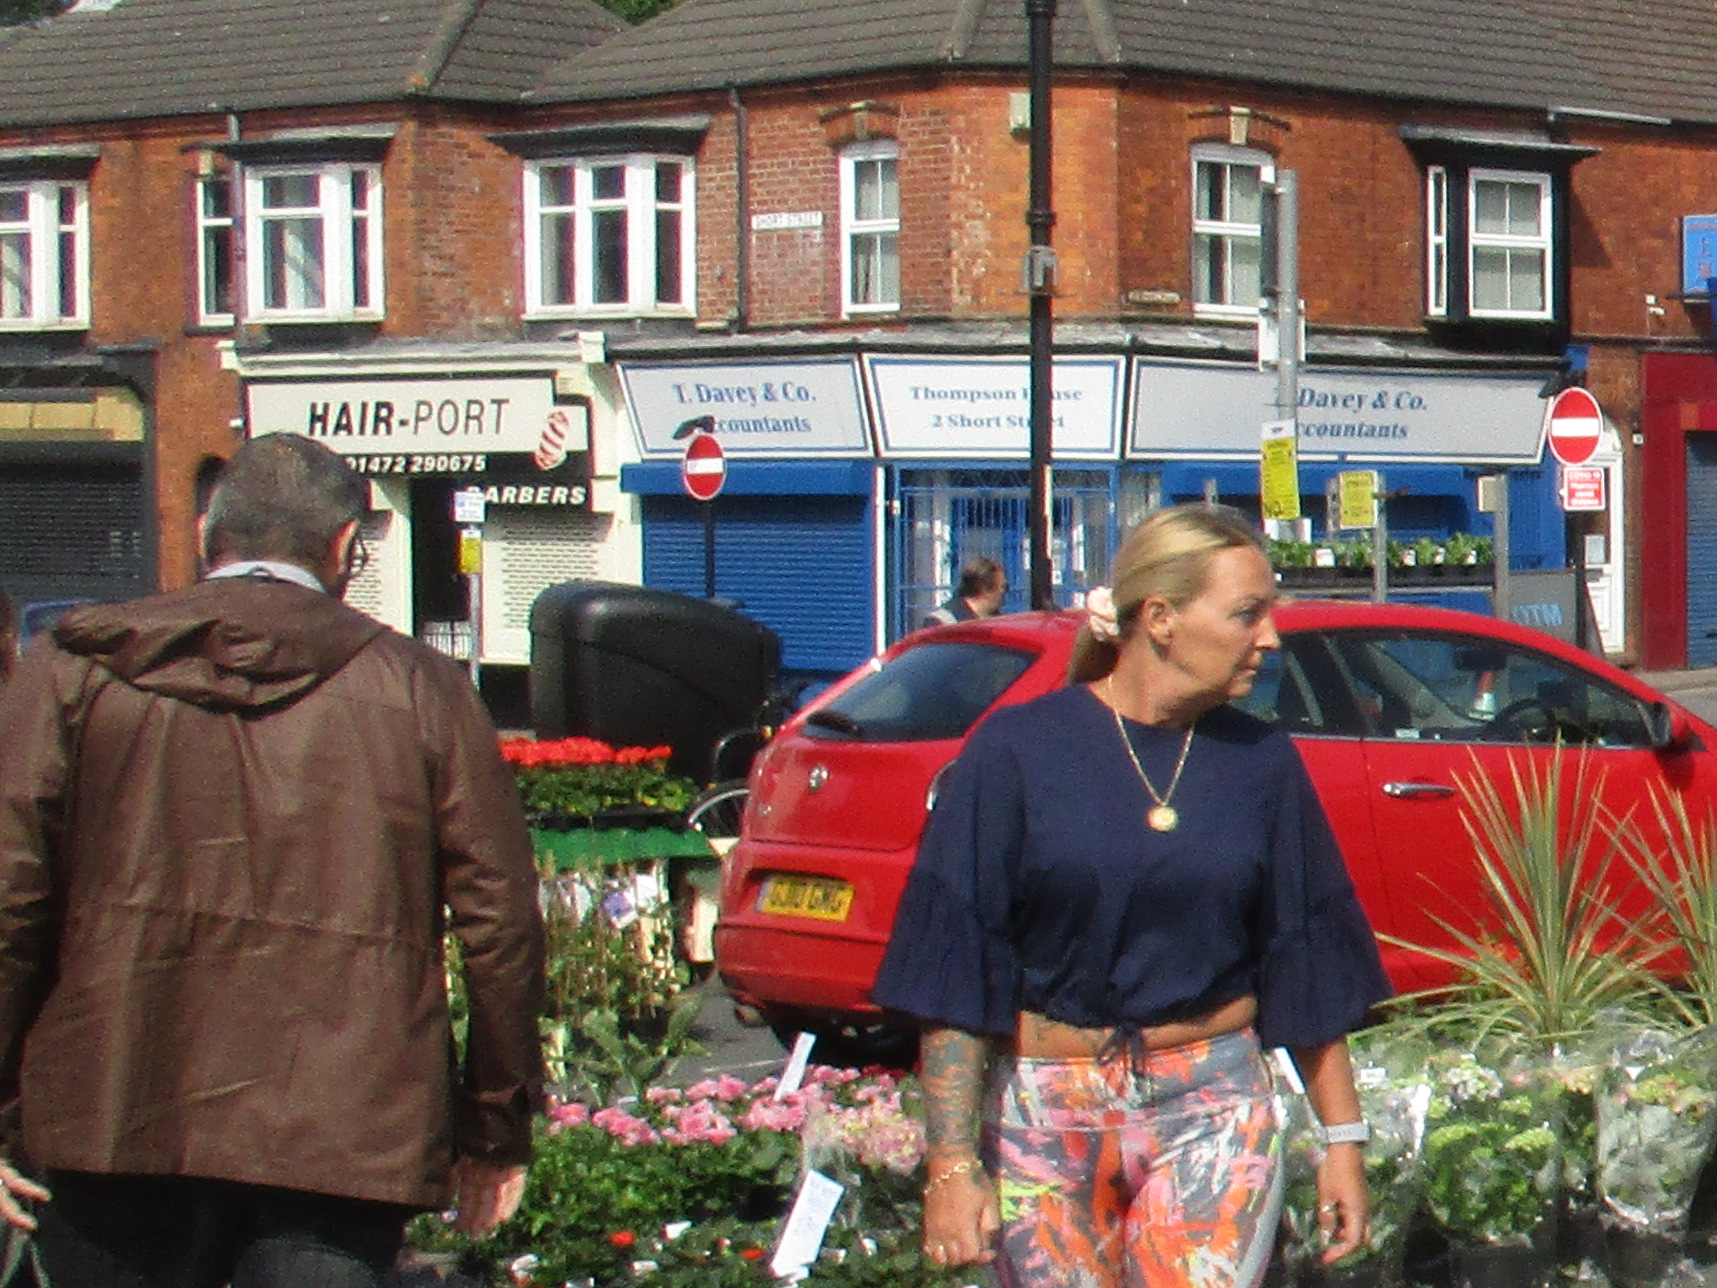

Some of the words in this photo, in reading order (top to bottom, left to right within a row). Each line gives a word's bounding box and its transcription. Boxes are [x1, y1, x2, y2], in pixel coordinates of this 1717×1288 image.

[695, 381, 757, 407] Davey
[761, 381, 778, 402] &
[782, 380, 816, 402] Co.
[909, 386, 1016, 404] Thompson
[1299, 387, 1368, 413] Davey
[1371, 390, 1389, 410] &
[1393, 390, 1428, 411] Co.
[307, 397, 511, 437] HAIR-PORT
[714, 414, 812, 434] countants
[931, 414, 943, 428] 2
[947, 413, 1001, 428] Short
[410, 454, 487, 473] 290675
